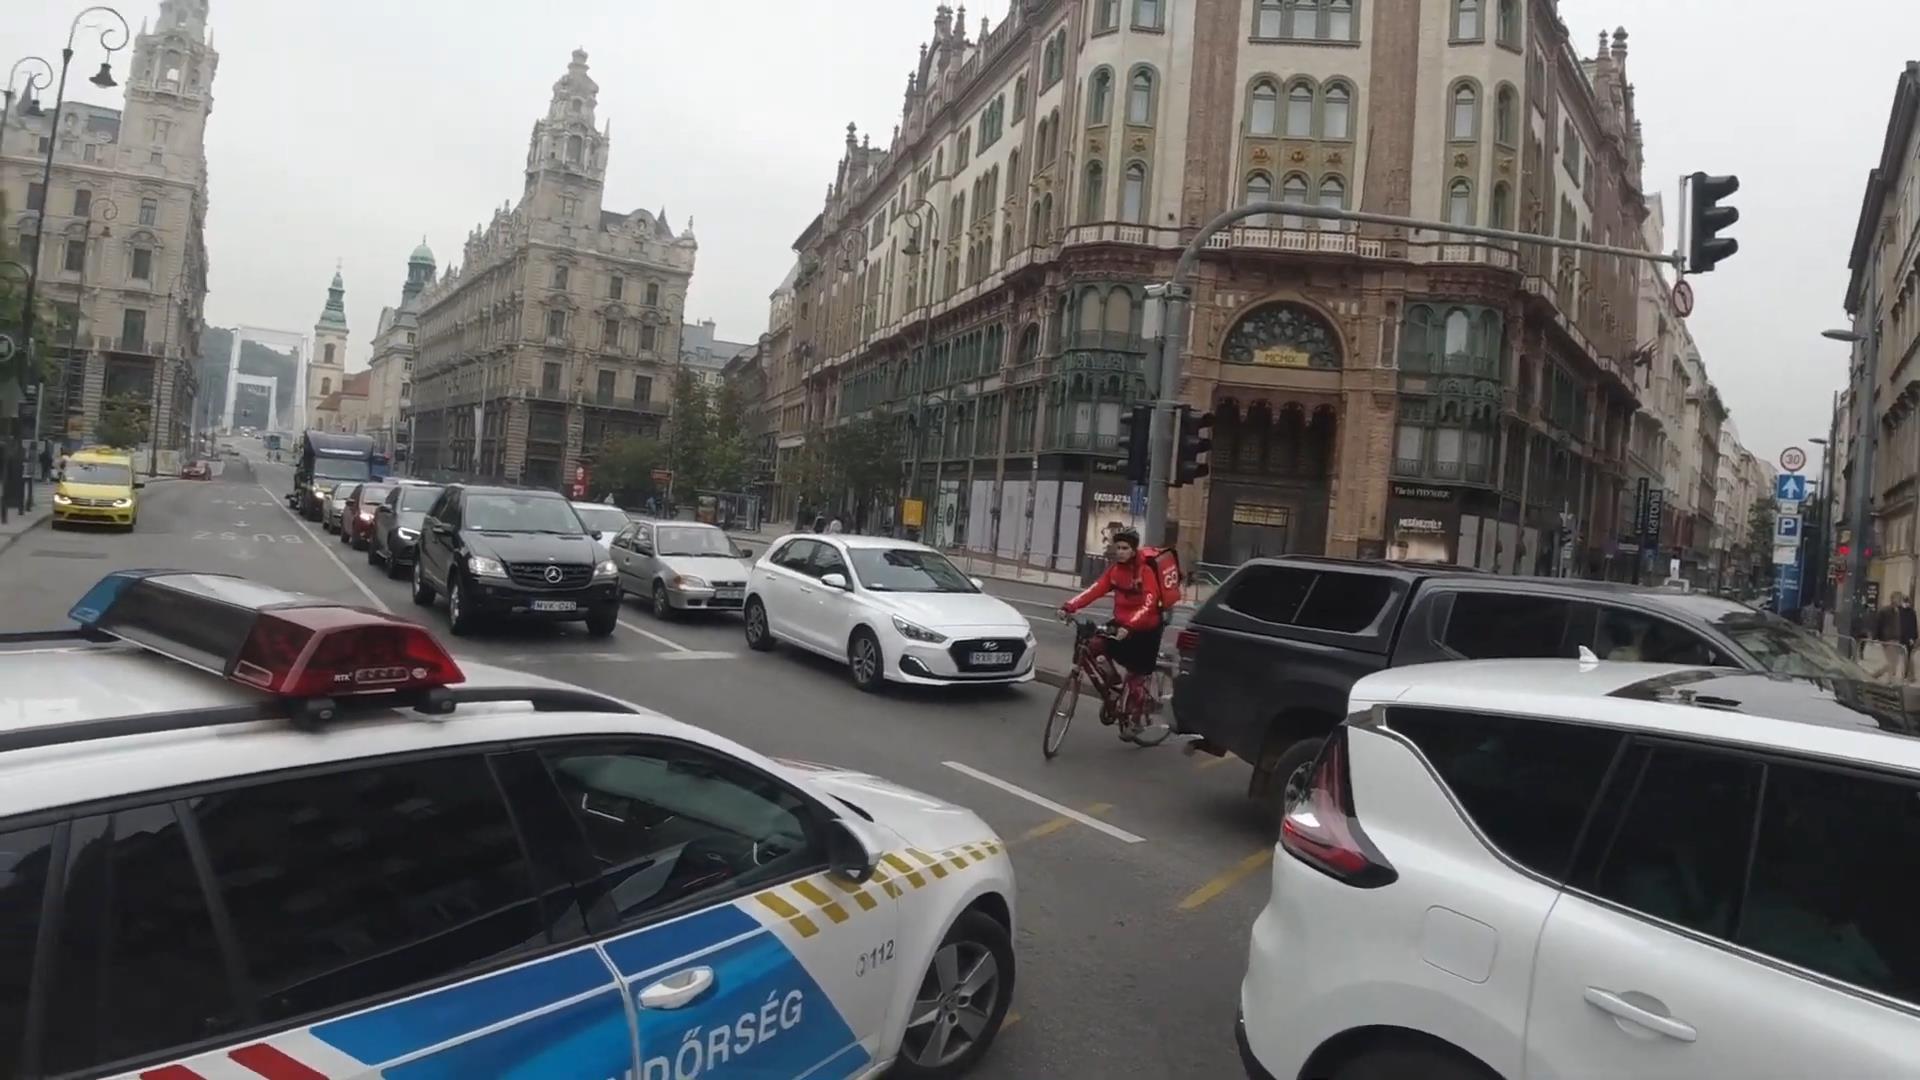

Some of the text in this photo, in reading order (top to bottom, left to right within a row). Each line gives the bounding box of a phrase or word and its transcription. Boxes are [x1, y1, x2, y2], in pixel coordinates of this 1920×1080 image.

[1785, 454, 1800, 465] 30
[1782, 518, 1794, 534] P
[192, 530, 304, 544] BUSZ
[1163, 571, 1178, 589] GO
[870, 939, 895, 970] 112
[606, 989, 804, 1080] DŐRSÉG
